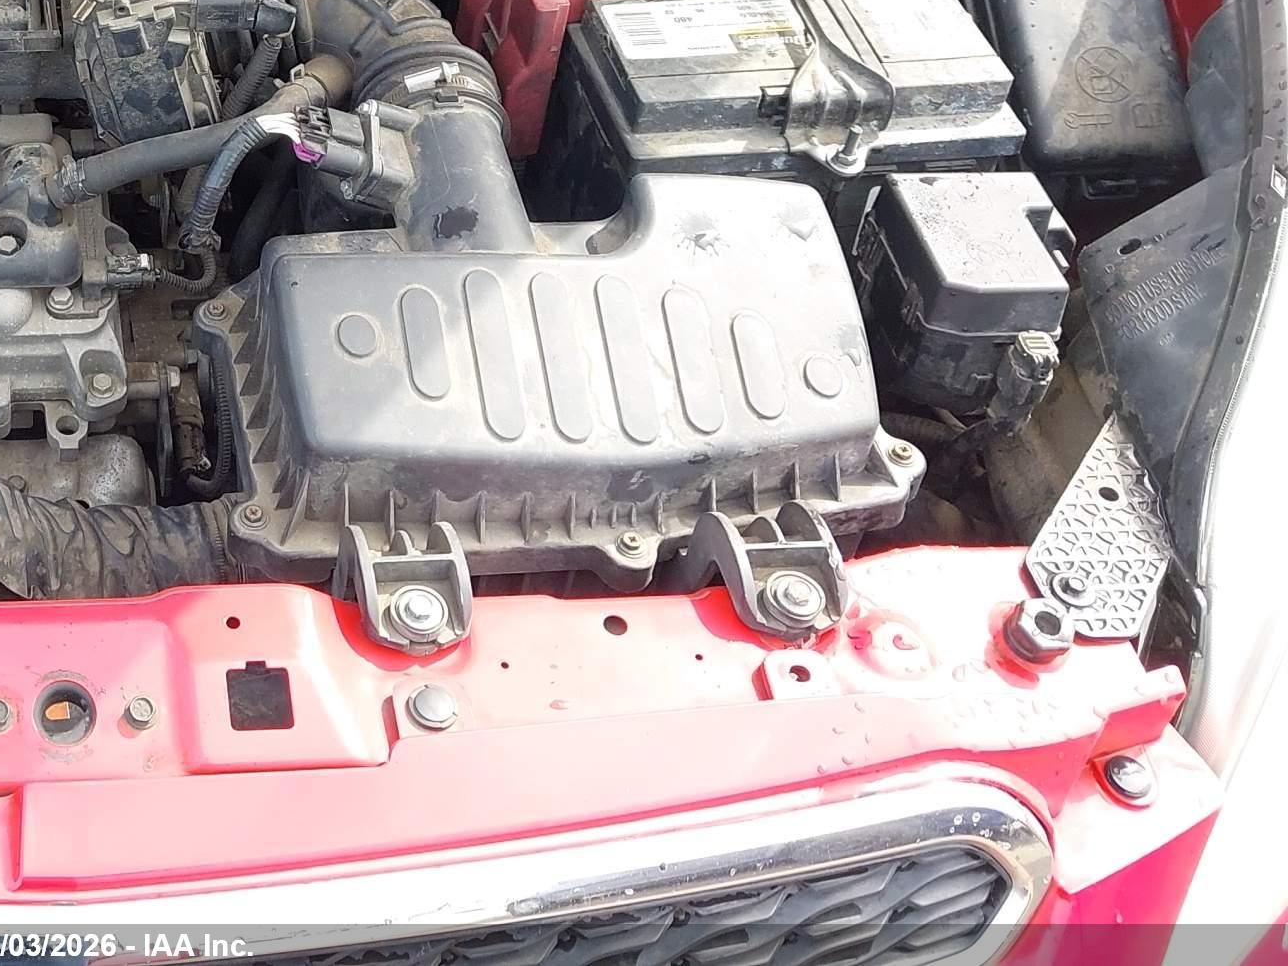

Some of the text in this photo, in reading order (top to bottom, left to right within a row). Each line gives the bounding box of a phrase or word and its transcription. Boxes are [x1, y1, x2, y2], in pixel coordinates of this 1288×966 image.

[1118, 282, 1148, 315] NOT
[1142, 272, 1173, 302] USE
[1167, 258, 1197, 290] THIS
[1136, 296, 1177, 332] HOOD
